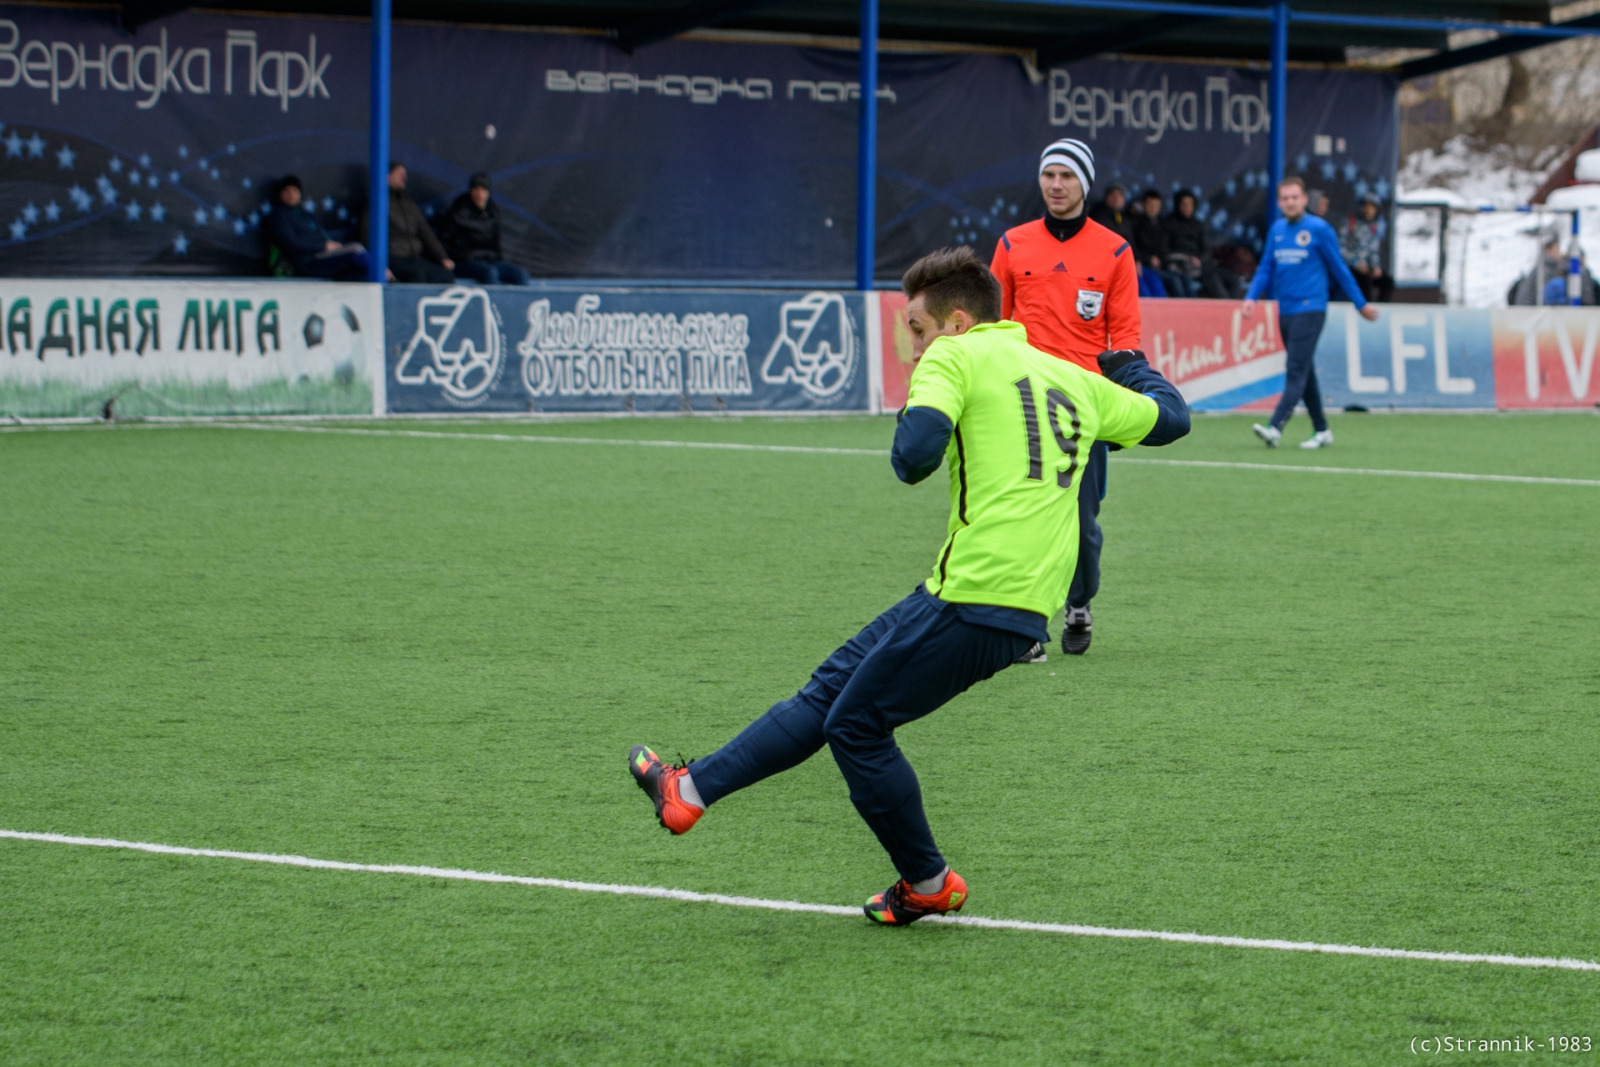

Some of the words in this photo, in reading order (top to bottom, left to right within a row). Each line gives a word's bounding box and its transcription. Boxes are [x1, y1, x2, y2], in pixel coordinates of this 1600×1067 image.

[225, 29, 332, 113] Парк
[1048, 68, 1198, 144] Вернадка
[0, 296, 161, 361] АДНАЯ
[178, 298, 281, 356] ЛИГА
[1345, 312, 1475, 395] LFL
[1509, 312, 1600, 401] TV
[521, 350, 683, 396] ФУТБОЛЬНАЯ
[687, 350, 752, 394] ЛИГА
[1012, 375, 1081, 489] 19
